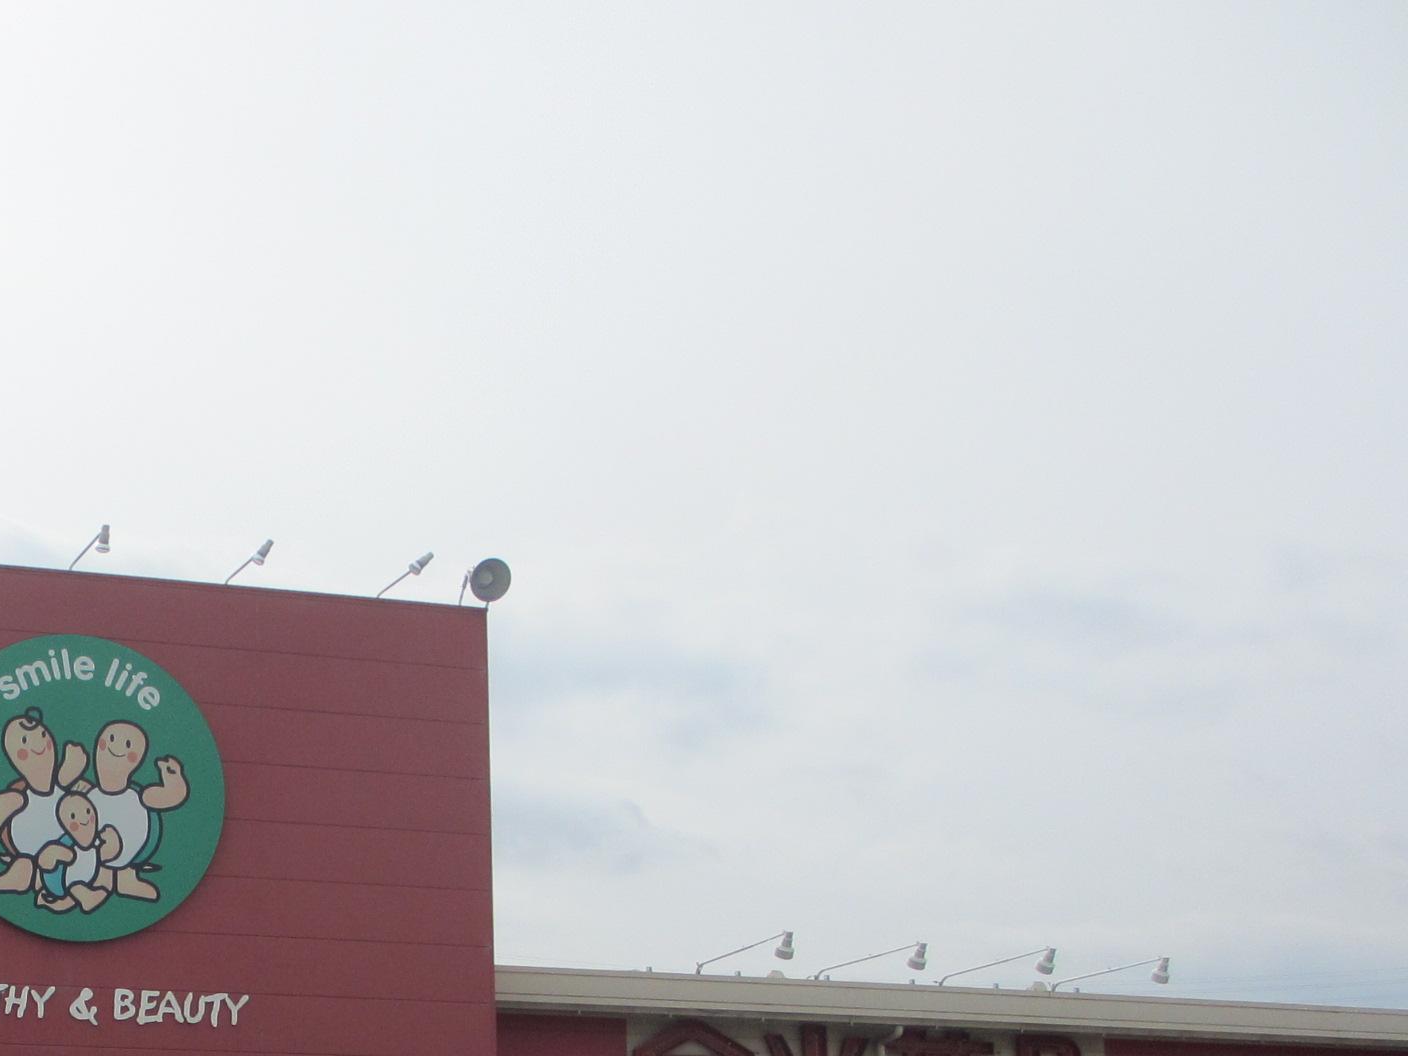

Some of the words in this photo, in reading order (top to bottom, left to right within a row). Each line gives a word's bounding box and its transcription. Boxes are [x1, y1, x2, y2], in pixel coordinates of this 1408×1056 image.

[105, 658, 161, 711] life
[68, 987, 98, 1026] &
[113, 988, 250, 1028] BEAUTY
